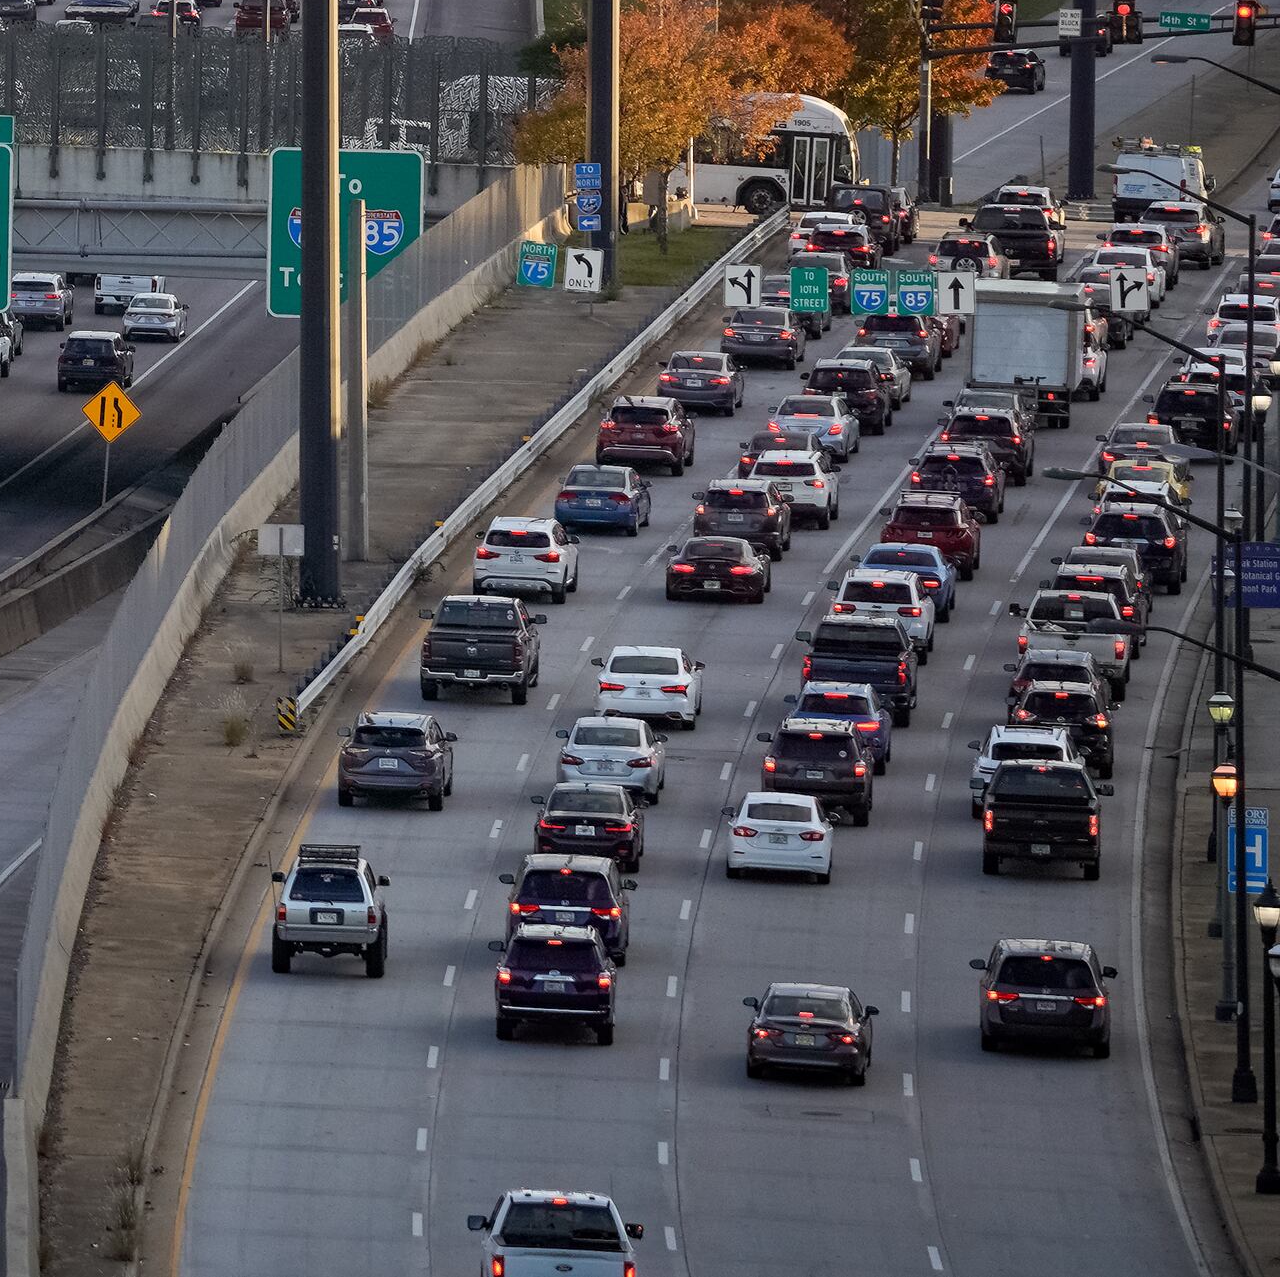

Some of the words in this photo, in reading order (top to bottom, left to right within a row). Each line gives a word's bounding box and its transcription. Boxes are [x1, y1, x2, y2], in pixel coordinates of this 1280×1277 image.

[1161, 15, 1180, 25] 14th
[1187, 17, 1197, 26] St
[793, 119, 812, 127] 1905
[522, 243, 555, 255] NORTH
[525, 261, 548, 279] 75
[804, 271, 814, 280] TO
[854, 273, 887, 281] SOUTH
[899, 274, 932, 283] SOUTH
[568, 278, 594, 288] ONLY
[800, 285, 819, 294] 10TH
[793, 298, 825, 307] STREET
[860, 291, 881, 306] 75
[905, 292, 927, 307] 85
[1253, 559, 1278, 568] Station
[1261, 585, 1278, 593] Park
[1230, 808, 1266, 819] EORY
